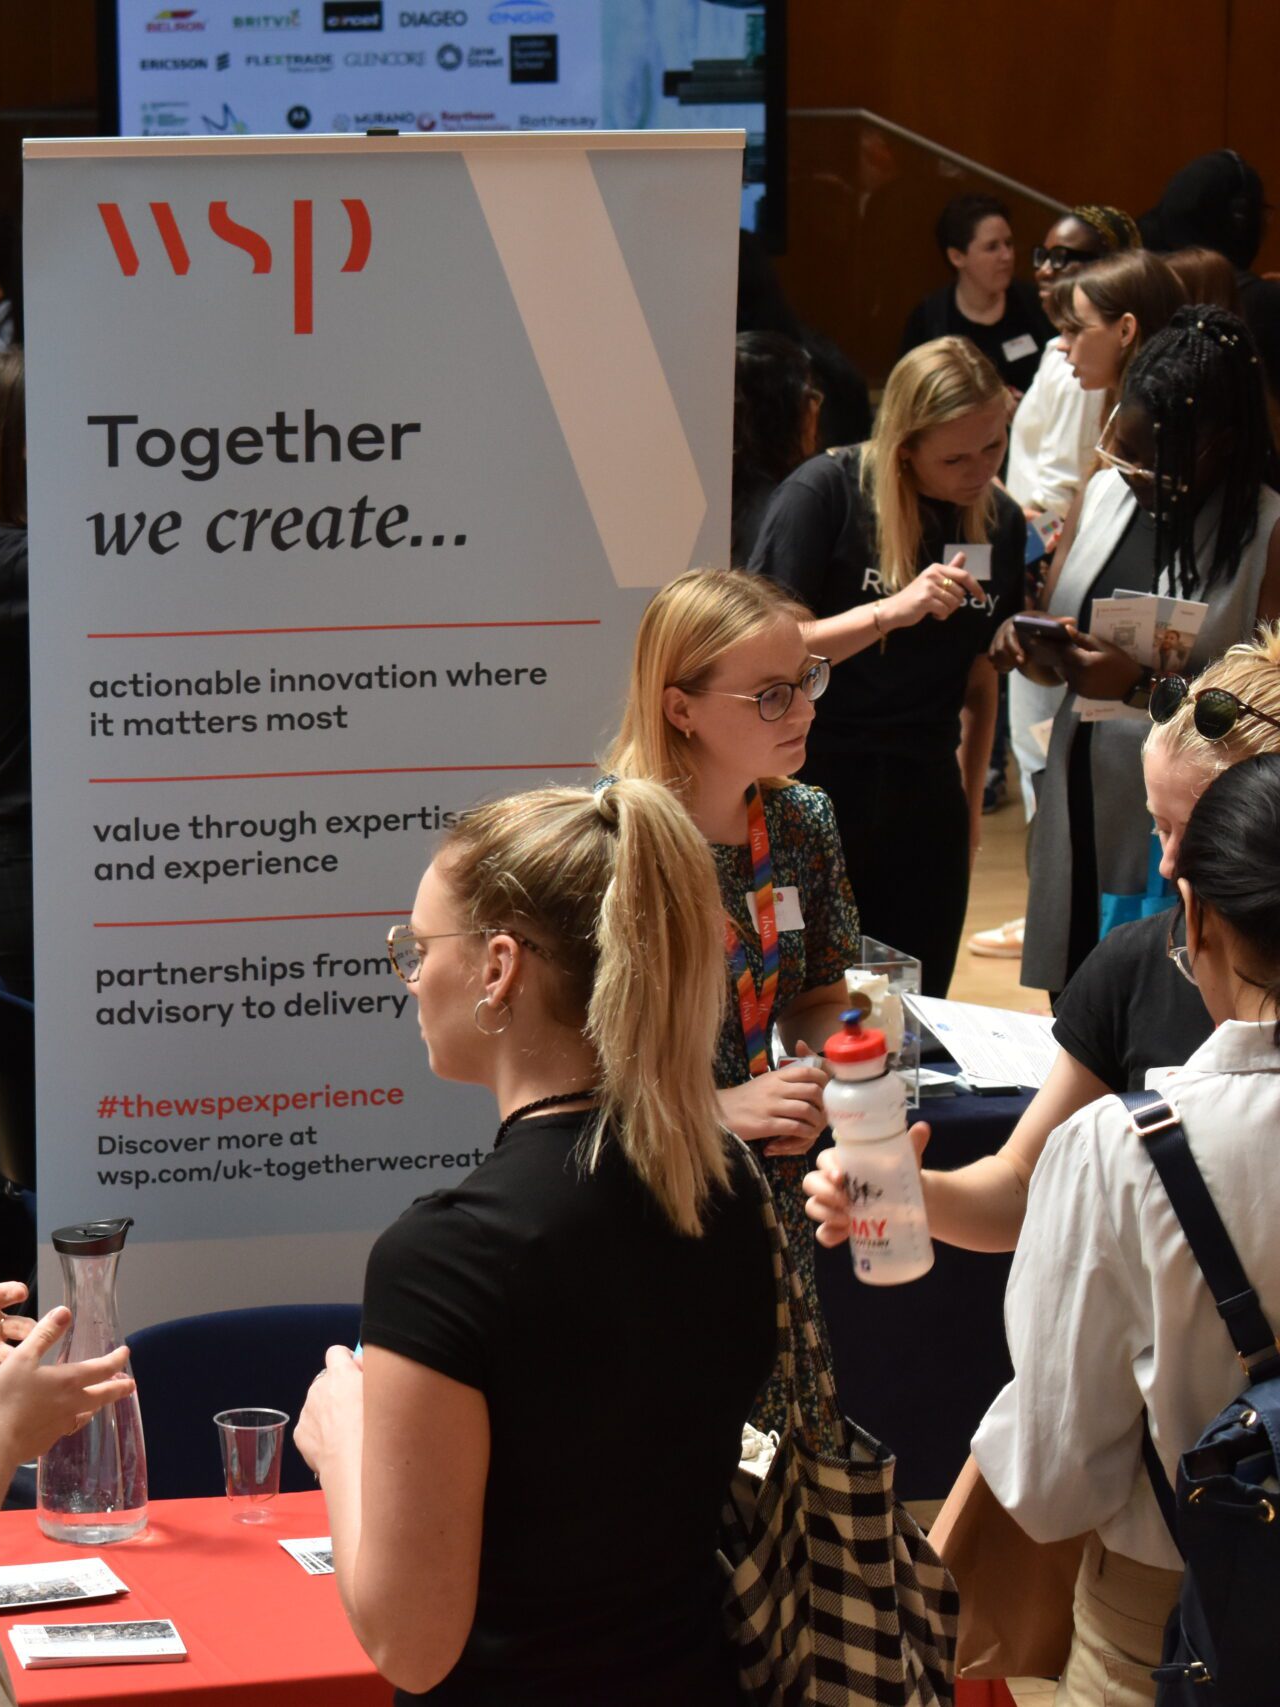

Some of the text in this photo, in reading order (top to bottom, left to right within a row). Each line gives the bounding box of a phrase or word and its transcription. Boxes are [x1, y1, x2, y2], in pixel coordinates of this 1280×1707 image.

[233, 12, 301, 29] BRITVIC
[399, 10, 468, 27] DIAGEO
[140, 57, 208, 71] ERICSSON
[344, 51, 426, 67] GLENCORE
[519, 113, 599, 129] Rothesay
[97, 199, 372, 334] wsp
[87, 409, 421, 481] Together
[86, 495, 466, 556] we create...
[89, 662, 547, 698] actionable innovation where
[91, 705, 347, 736] it matters most
[93, 805, 465, 842] value through expertis
[95, 851, 338, 884] and experience
[97, 956, 304, 993] partnerships
[313, 953, 393, 977] from
[96, 991, 408, 1027] advisory to delivery
[97, 1085, 403, 1120] #thewspexperience
[99, 1126, 317, 1155] Discover more at
